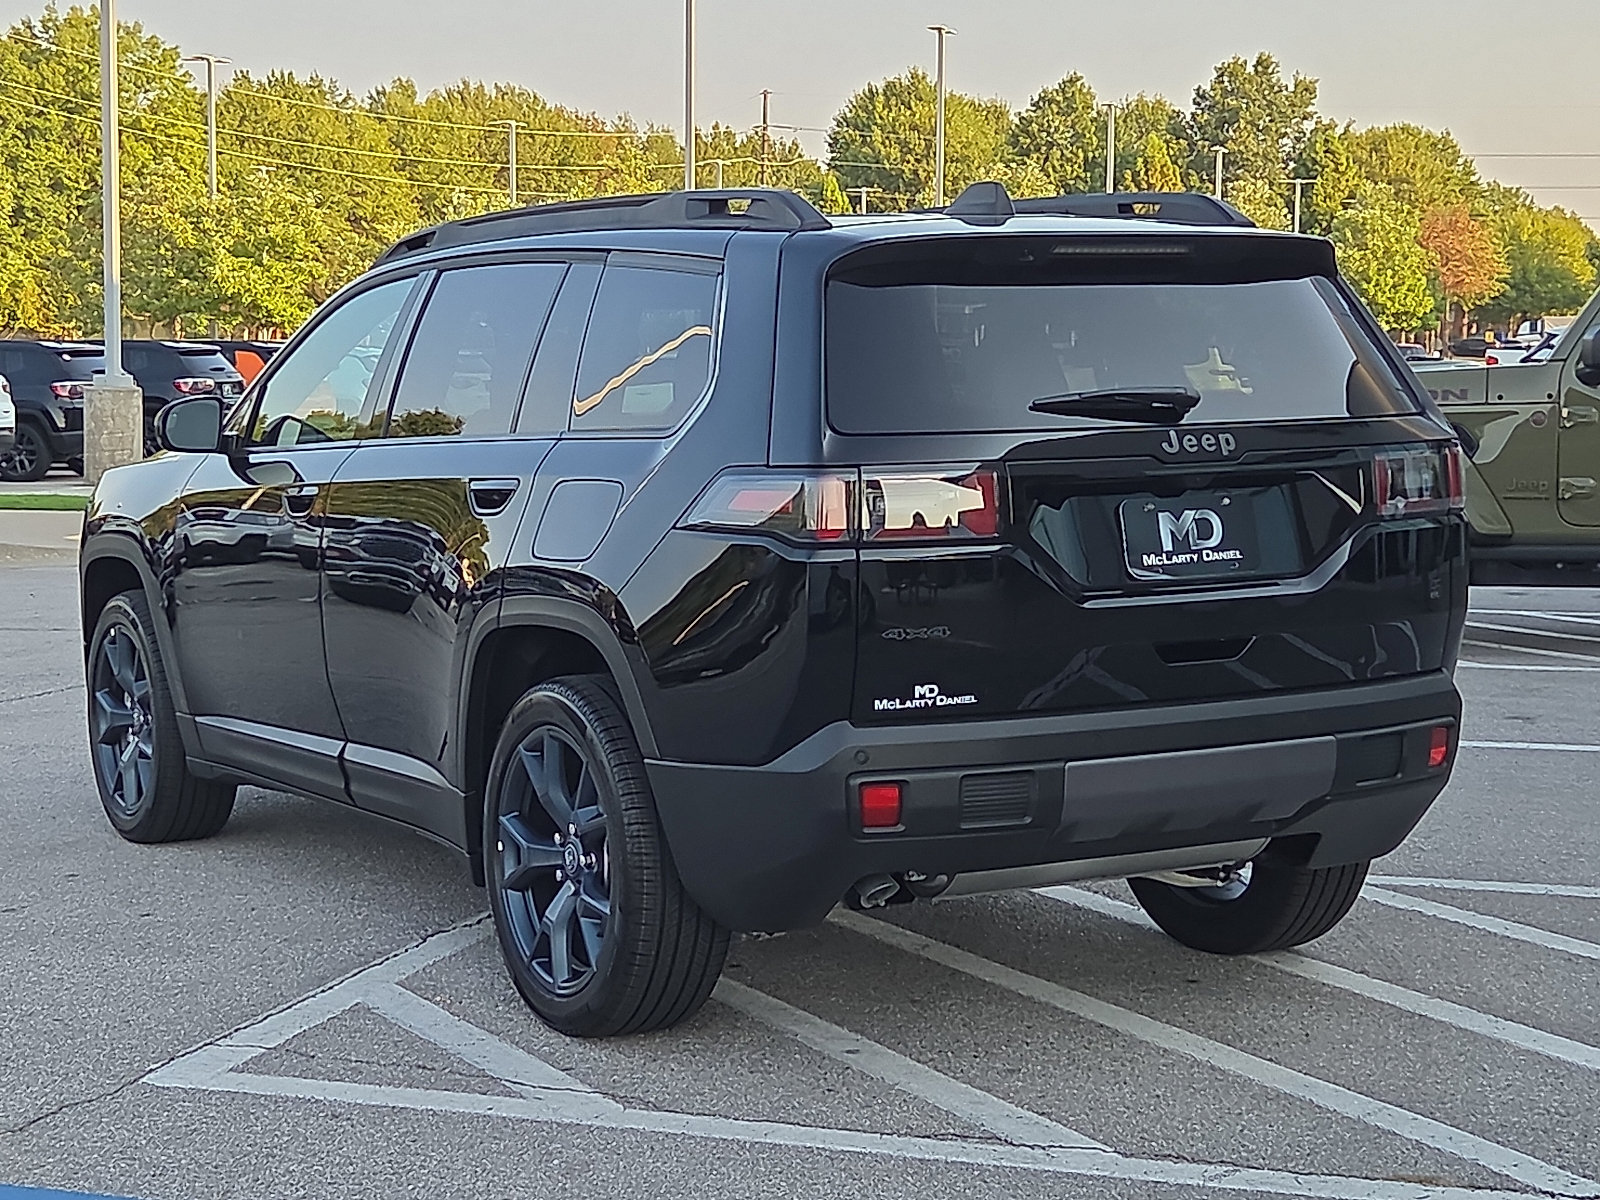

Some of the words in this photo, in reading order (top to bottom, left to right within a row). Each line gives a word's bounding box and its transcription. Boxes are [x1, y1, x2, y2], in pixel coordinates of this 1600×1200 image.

[1161, 429, 1236, 456] Jeep
[1506, 477, 1549, 493] Jeep
[1157, 509, 1223, 551] MD
[1202, 549, 1243, 562] DANIEL
[914, 684, 939, 698] MD
[935, 695, 978, 706] DANIEL
